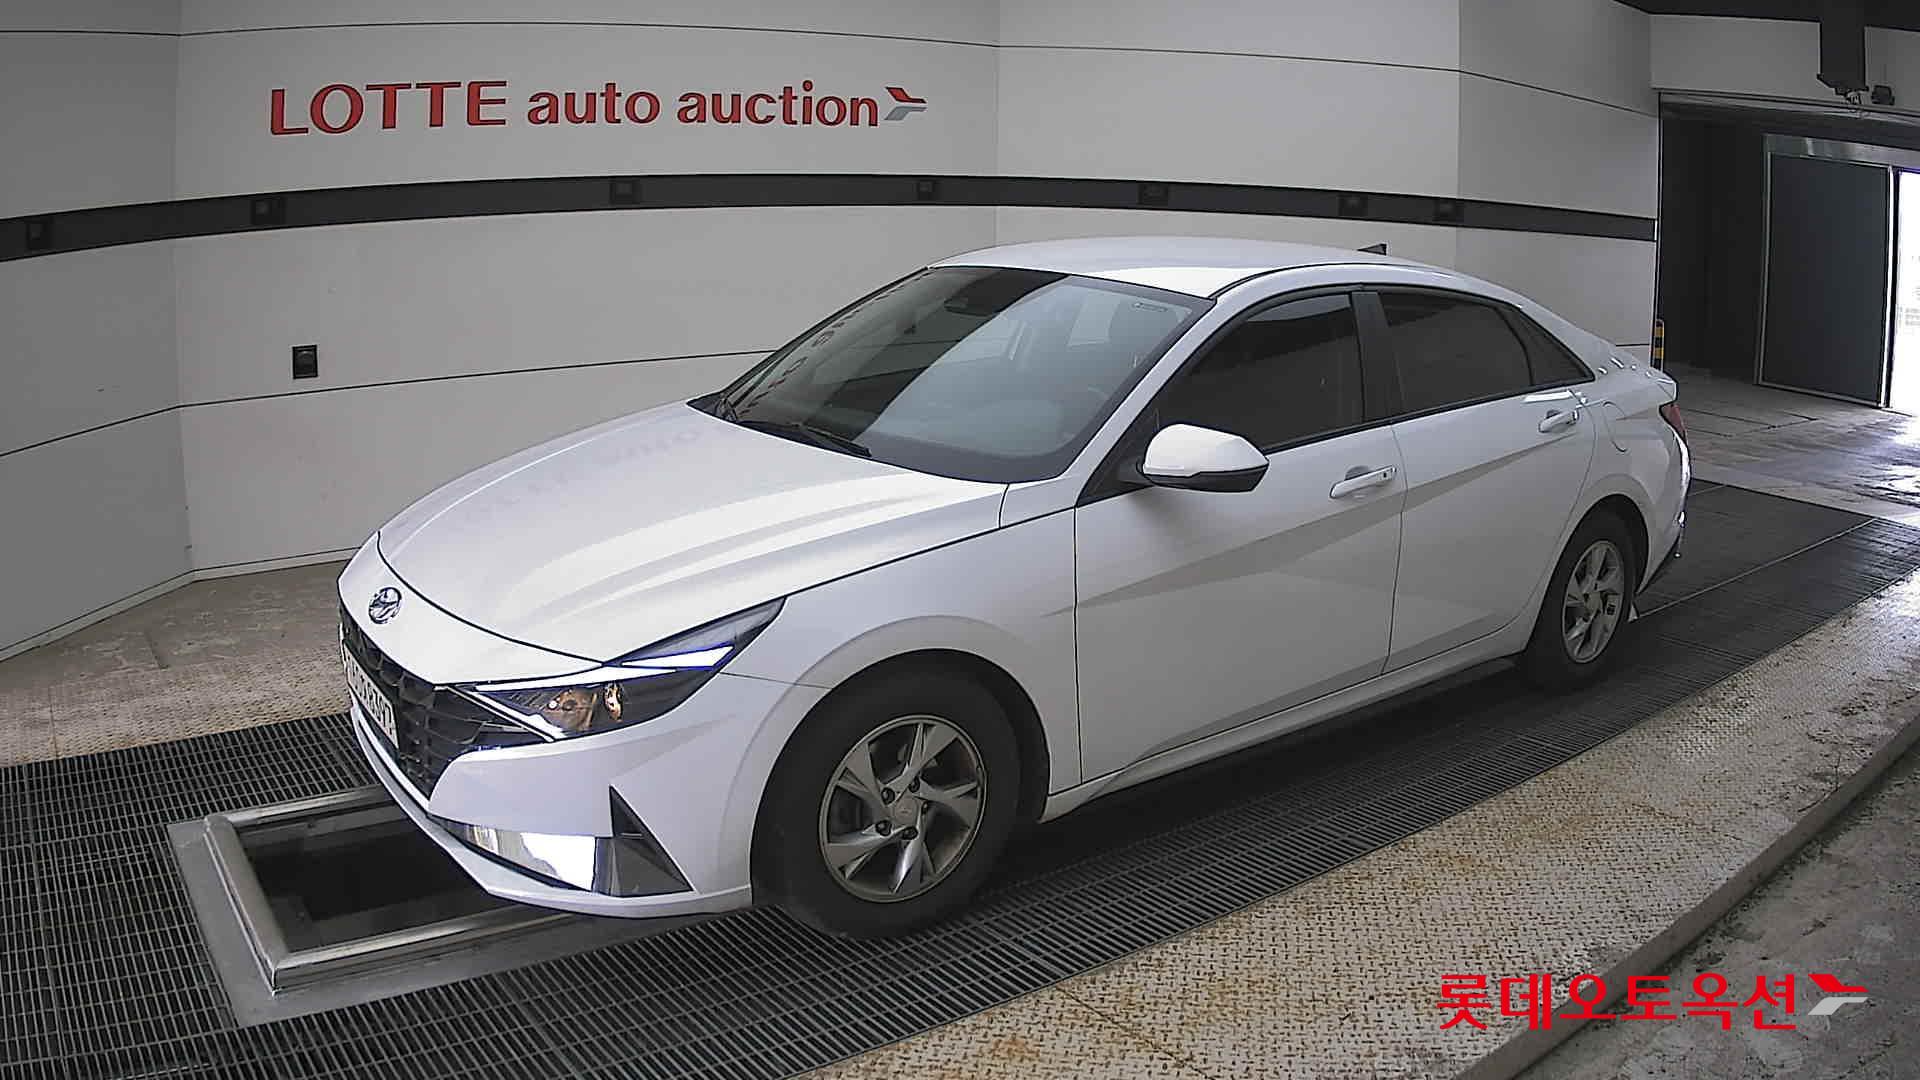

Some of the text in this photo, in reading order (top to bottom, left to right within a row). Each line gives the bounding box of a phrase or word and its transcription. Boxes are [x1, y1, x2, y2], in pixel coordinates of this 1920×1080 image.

[270, 80, 878, 136] LOTTE auto auction
